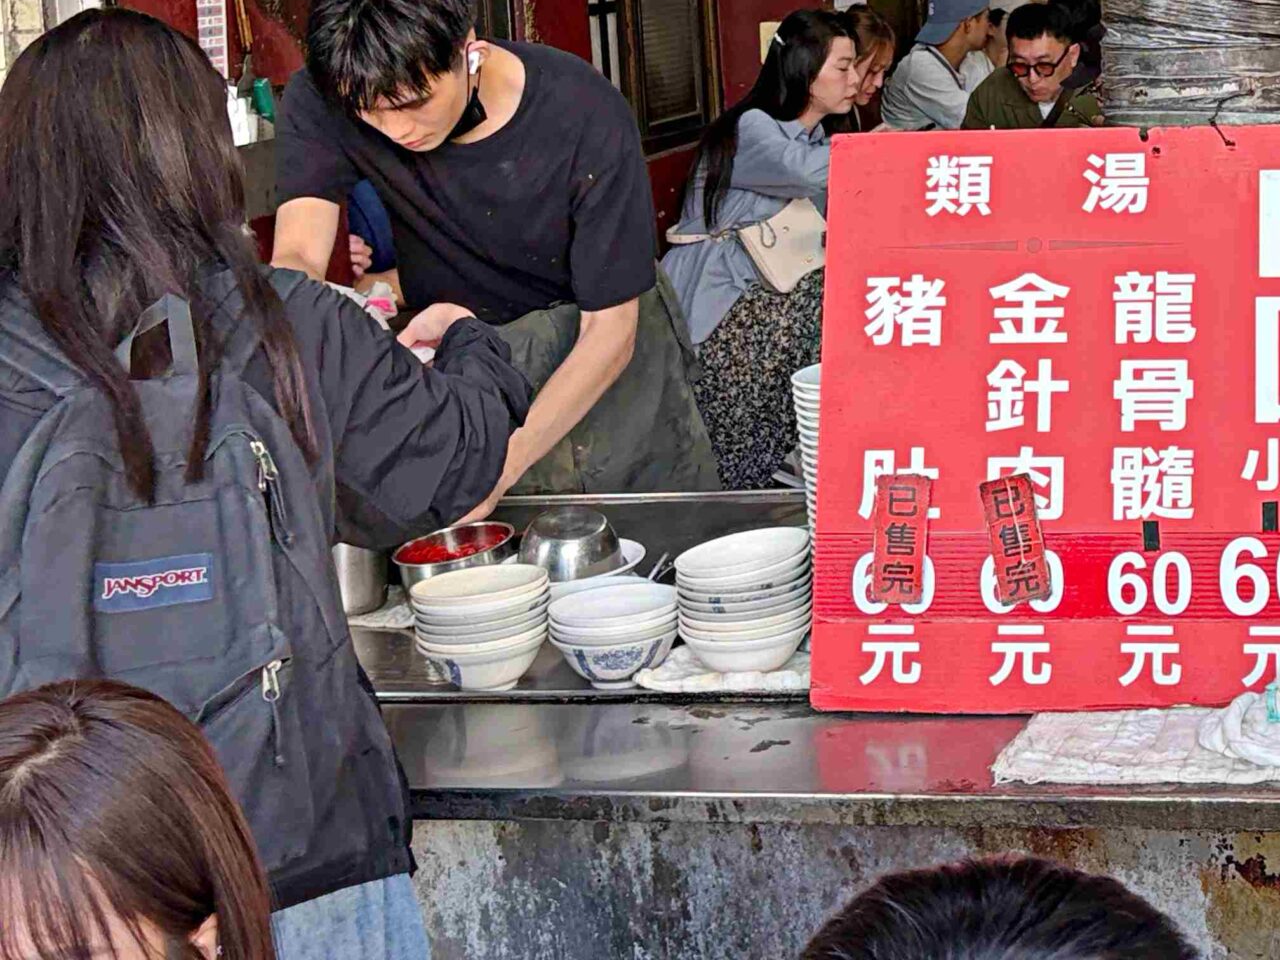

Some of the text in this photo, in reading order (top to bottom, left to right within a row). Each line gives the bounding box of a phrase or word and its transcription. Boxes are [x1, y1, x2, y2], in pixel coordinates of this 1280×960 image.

[1110, 270, 1197, 521] 龍骨髓
[880, 484, 919, 596] 已售完
[991, 484, 1041, 597] 已售完
[1107, 550, 1193, 617] 60
[859, 624, 922, 686] 元
[988, 624, 1053, 687] 元
[1119, 626, 1183, 687] 元
